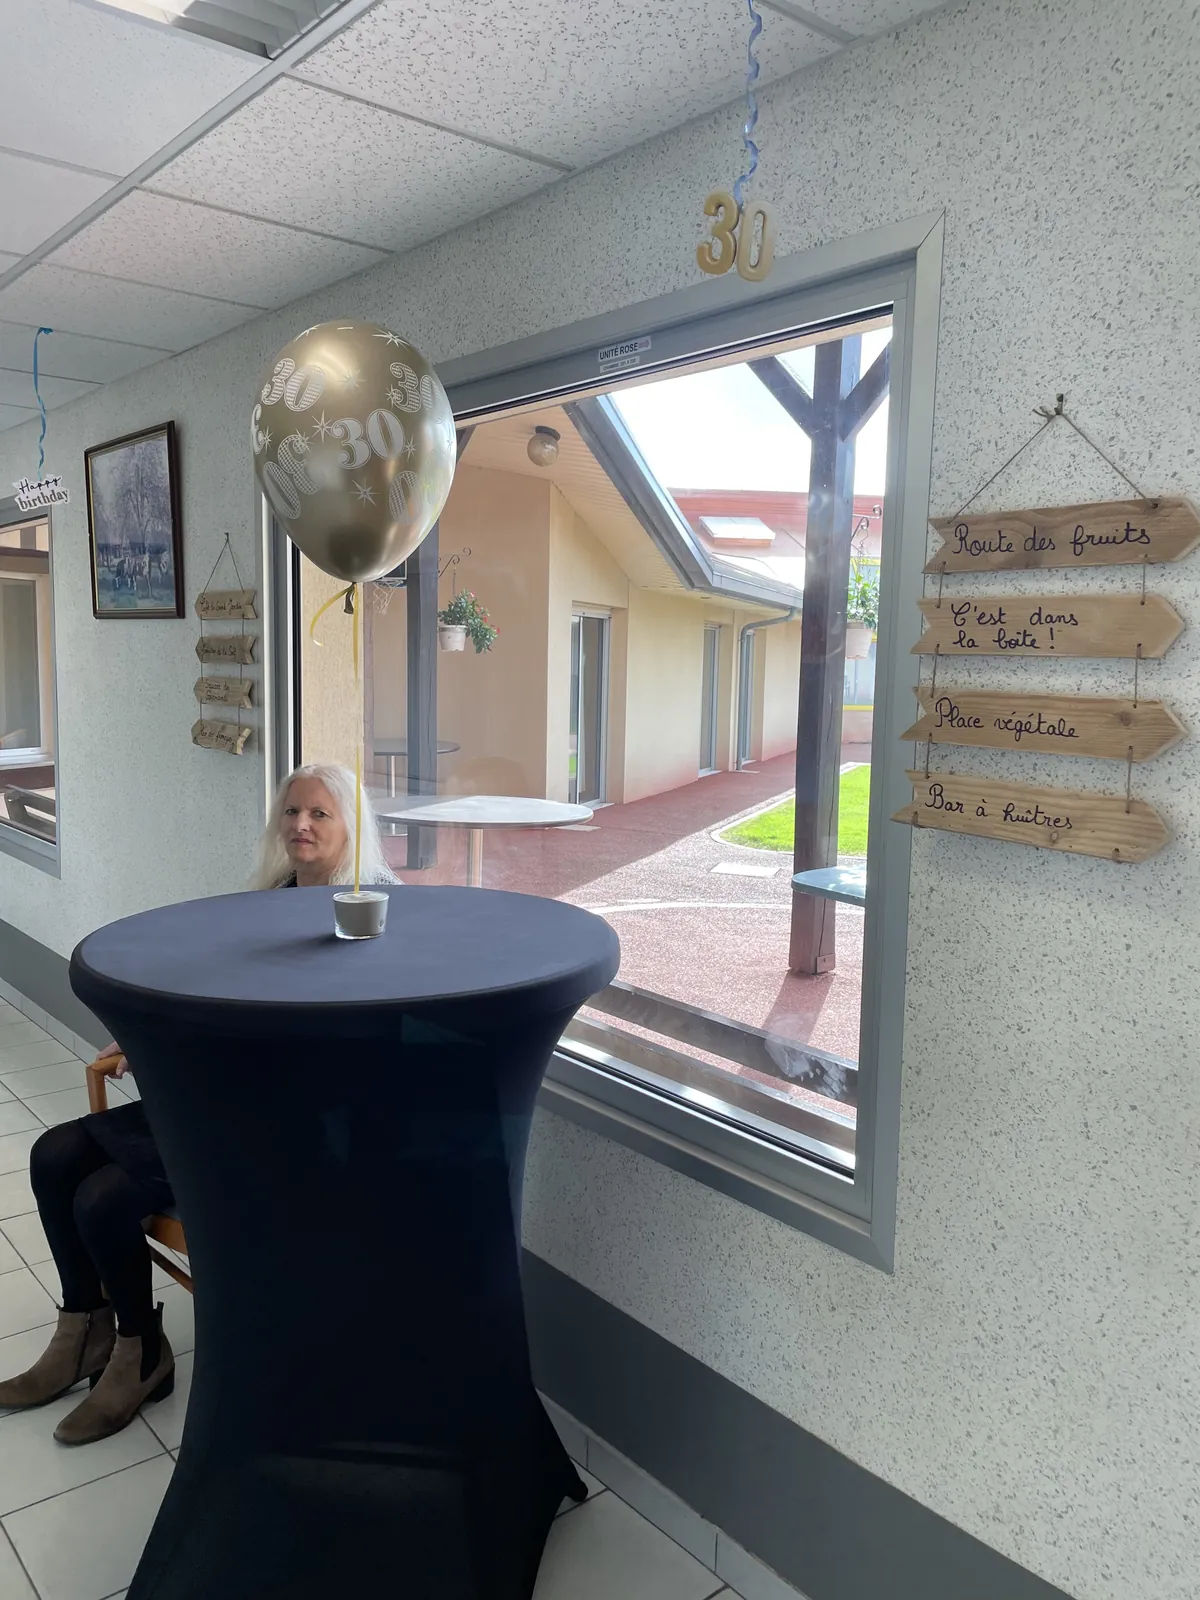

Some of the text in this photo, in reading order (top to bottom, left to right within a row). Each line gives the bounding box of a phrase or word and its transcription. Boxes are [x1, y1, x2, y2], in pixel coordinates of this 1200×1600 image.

[696, 187, 778, 282] 30
[619, 342, 638, 355] ROSE
[262, 358, 324, 411] 30
[331, 408, 405, 470] 30
[18, 489, 68, 509] birthday
[19, 477, 61, 494] Happy
[952, 521, 1150, 557] Route des fruits
[951, 602, 1078, 626] C'est dans
[952, 630, 979, 648] la
[935, 697, 1079, 742] Place végétale
[925, 783, 1073, 830] Bar à huîtres
